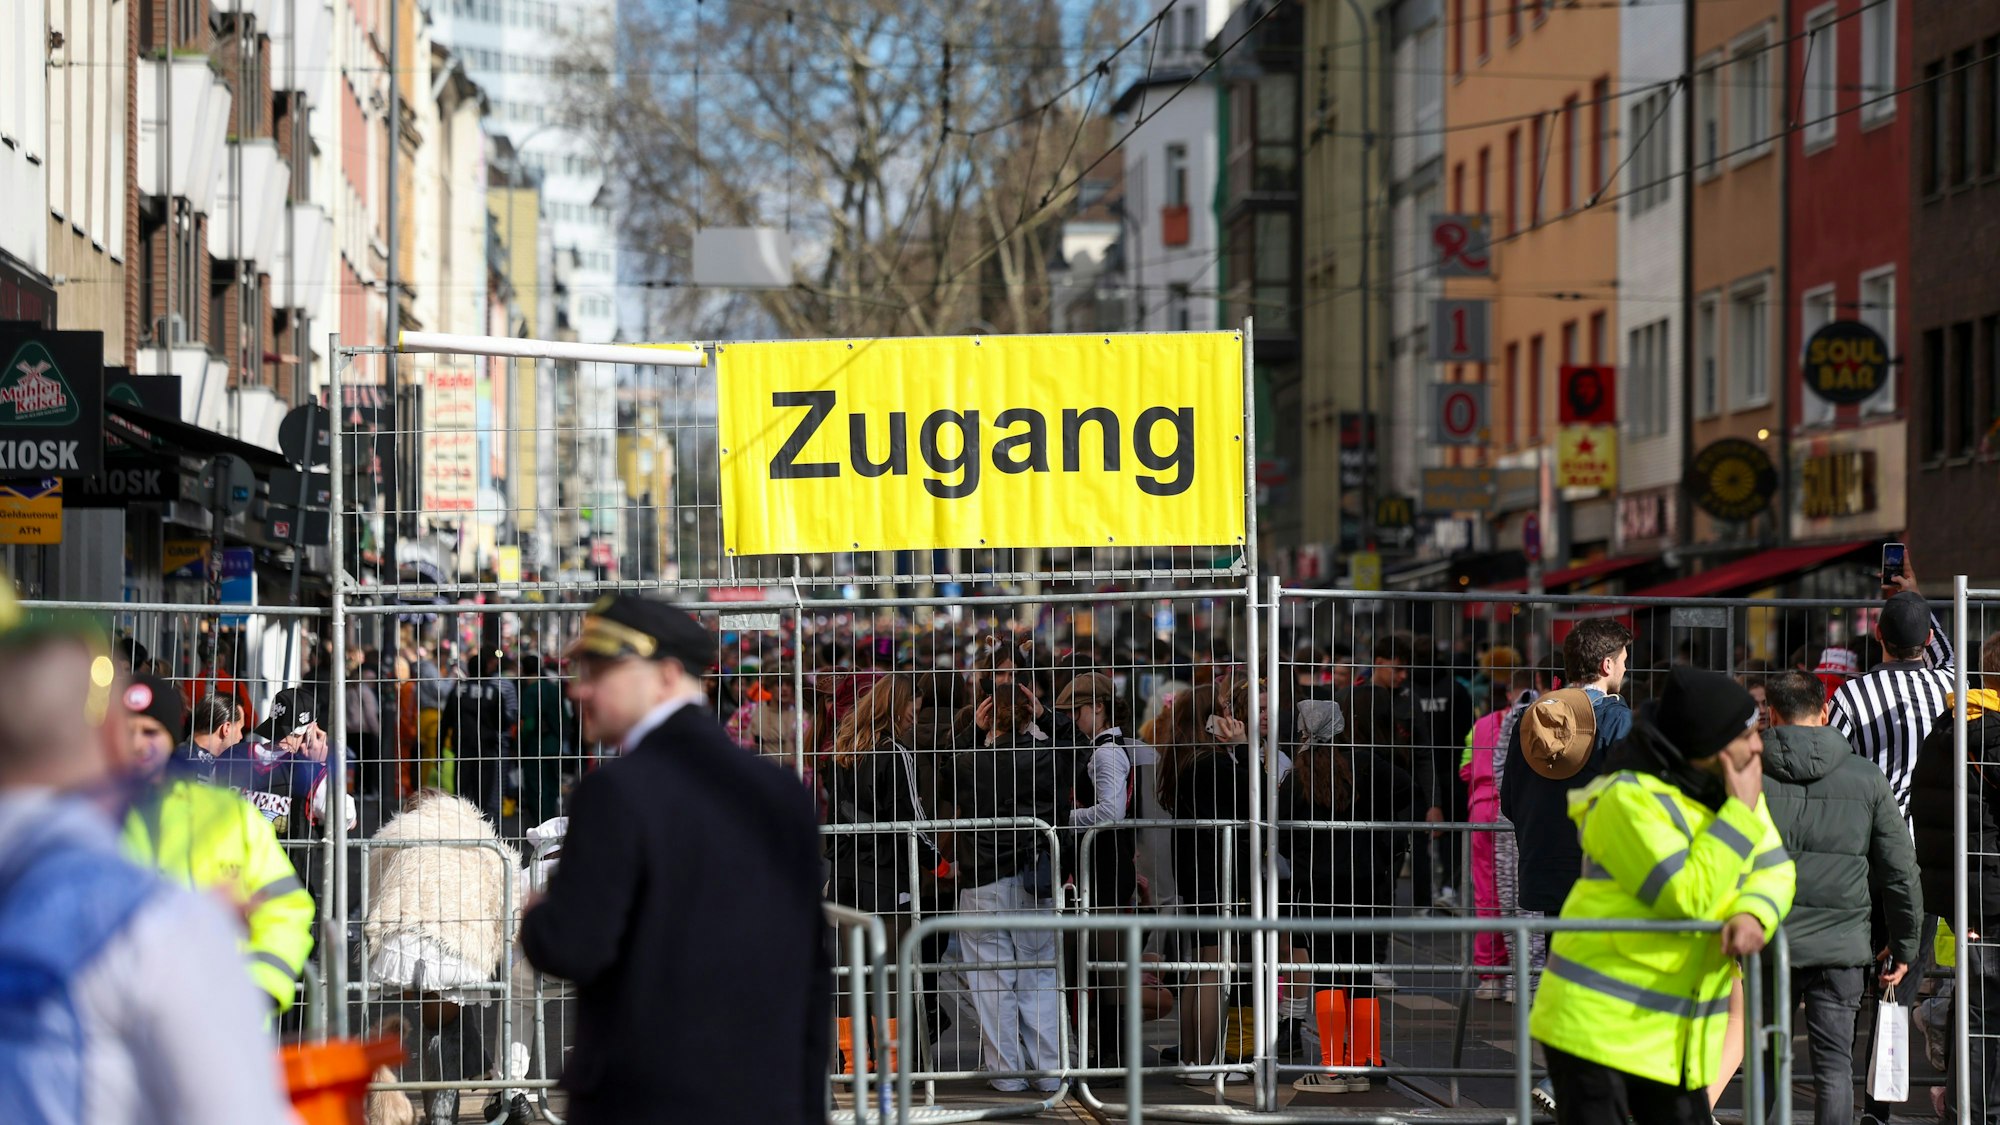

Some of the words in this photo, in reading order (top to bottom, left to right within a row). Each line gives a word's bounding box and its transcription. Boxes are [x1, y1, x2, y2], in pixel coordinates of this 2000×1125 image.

[1810, 338, 1883, 364] SOUL
[1819, 365, 1875, 389] BAR
[16, 393, 66, 414] Kölsch
[769, 389, 1195, 499] Zugang
[1561, 459, 1609, 473] CUBA
[83, 469, 161, 495] KIOSK
[1568, 475, 1603, 486] BAR
[0, 510, 58, 520] Geldautomat
[19, 526, 41, 535] ATM
